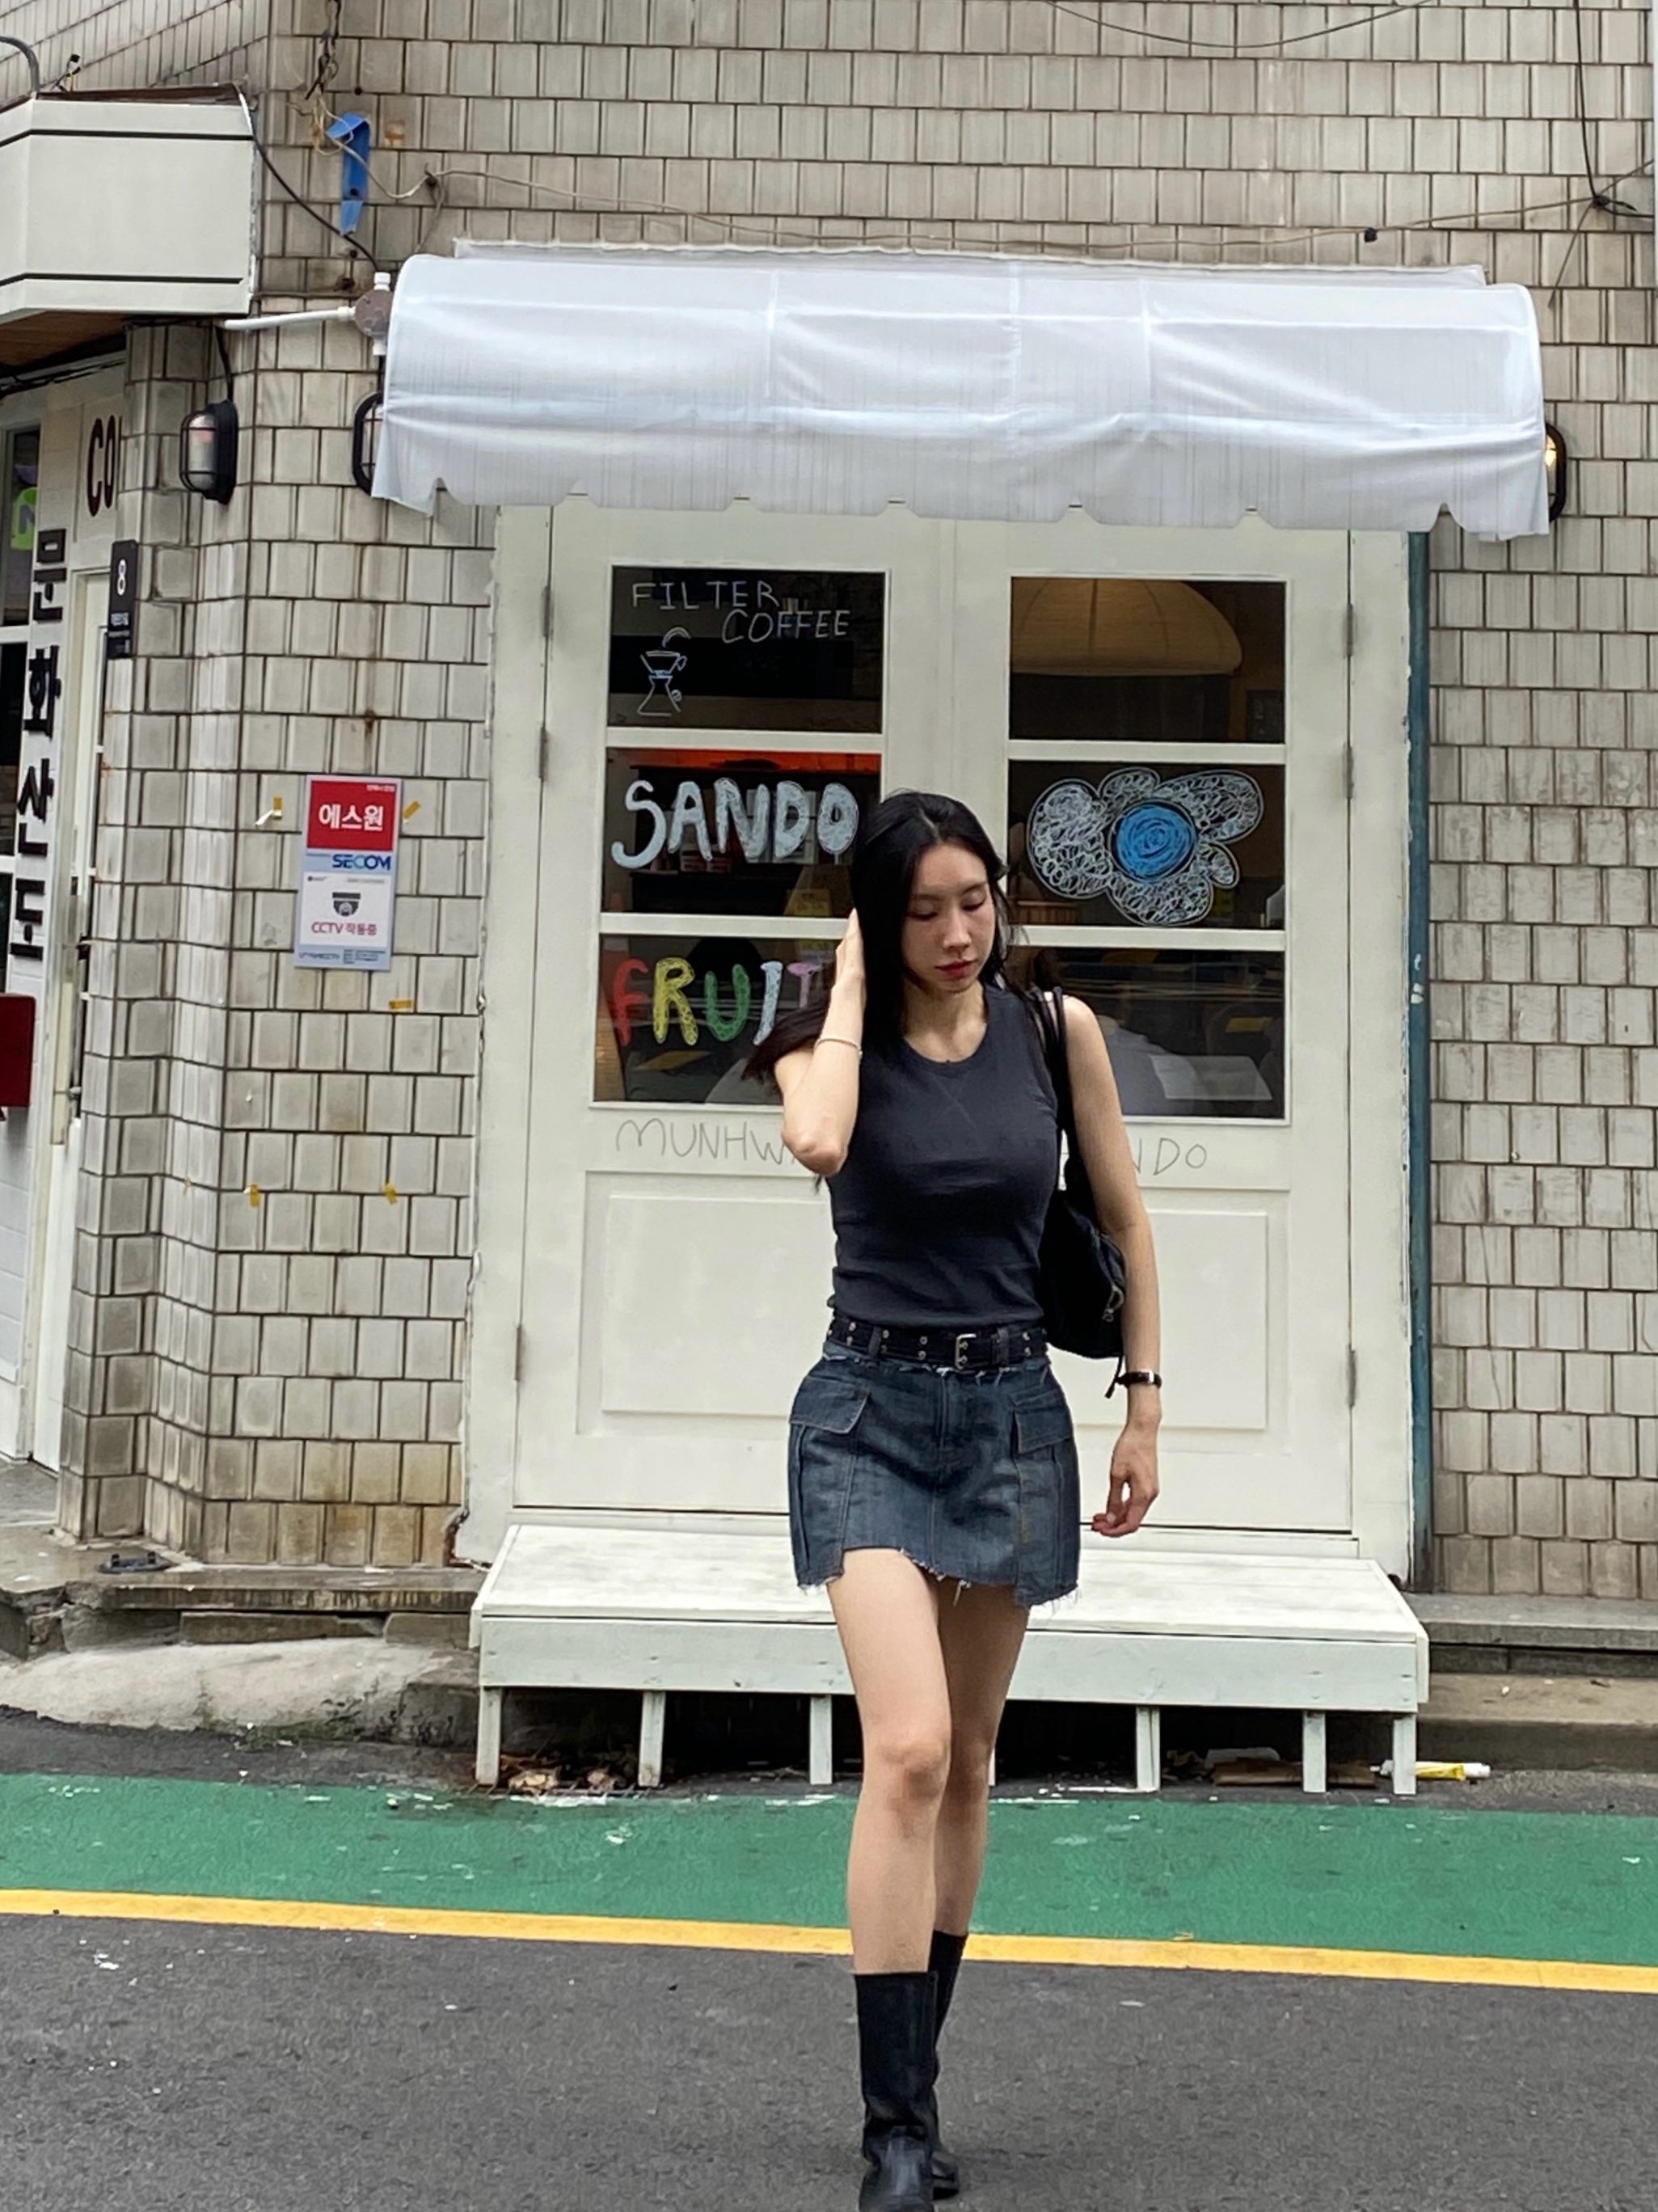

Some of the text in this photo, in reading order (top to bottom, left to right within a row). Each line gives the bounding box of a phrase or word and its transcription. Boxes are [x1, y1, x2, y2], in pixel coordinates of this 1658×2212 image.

[116, 558, 127, 596] 8
[631, 580, 780, 610] FILTER
[722, 609, 851, 644] COFFEE
[9, 528, 67, 960] 문화산도
[318, 803, 385, 832] 에스원
[610, 776, 859, 870] SANDO
[331, 854, 391, 871] SECOM
[310, 921, 344, 935] CCTV
[615, 1117, 796, 1166] MUNHW
